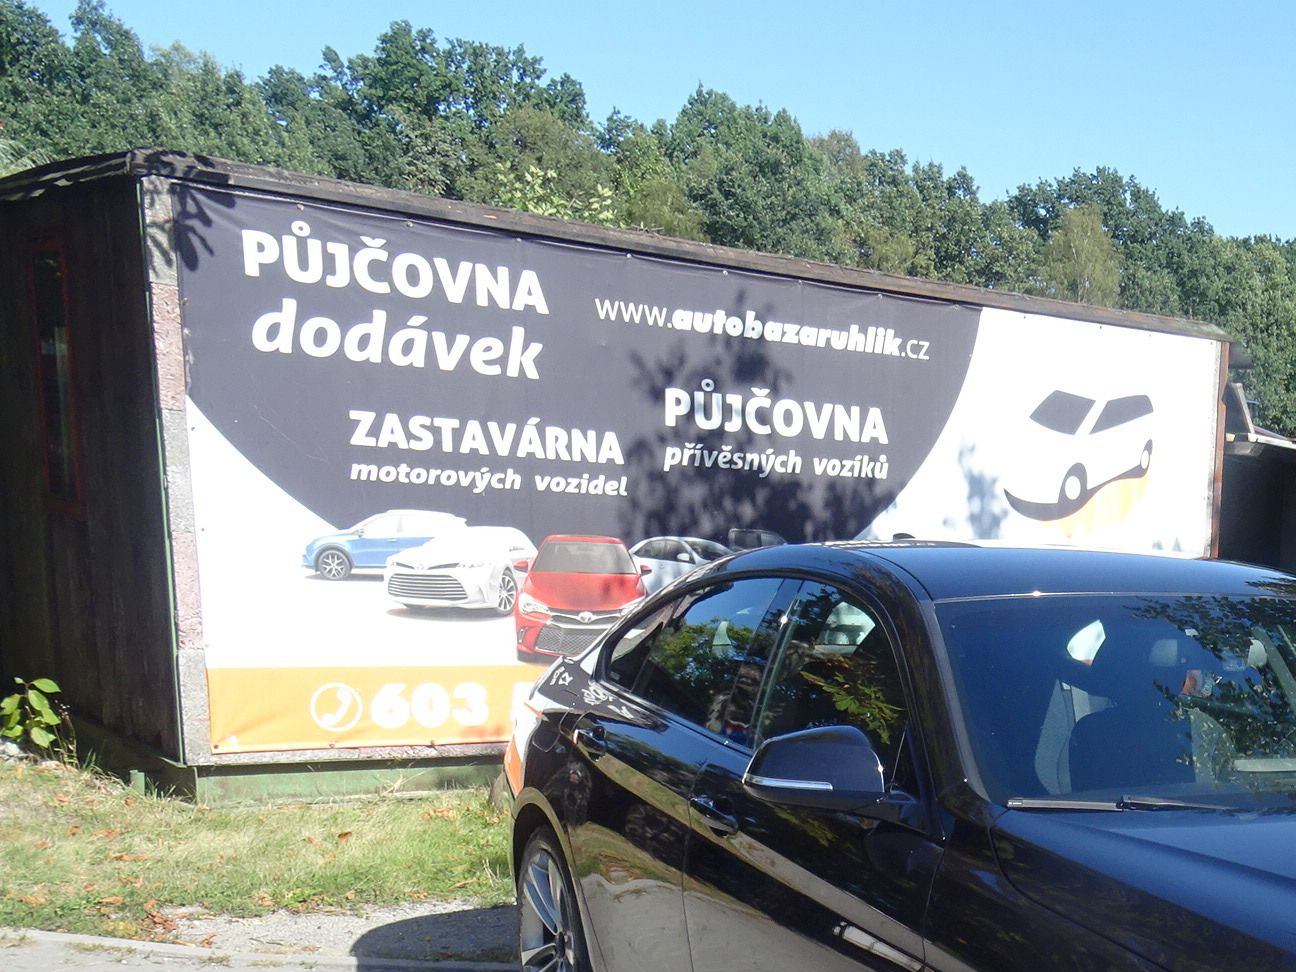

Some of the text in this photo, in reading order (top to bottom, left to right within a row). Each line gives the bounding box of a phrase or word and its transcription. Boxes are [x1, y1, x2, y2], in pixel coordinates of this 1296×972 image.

[241, 220, 550, 315] PŮJČOVNA
[251, 298, 543, 379] dodávek
[594, 298, 930, 360] www.autobazaruhlik.cz
[349, 410, 625, 465] ZASTAVÁRNA
[663, 378, 889, 444] PŮJČOVNA
[350, 463, 628, 496] motorových vozidel
[663, 442, 889, 479] přívěsných vozíků
[370, 682, 489, 729] 603
